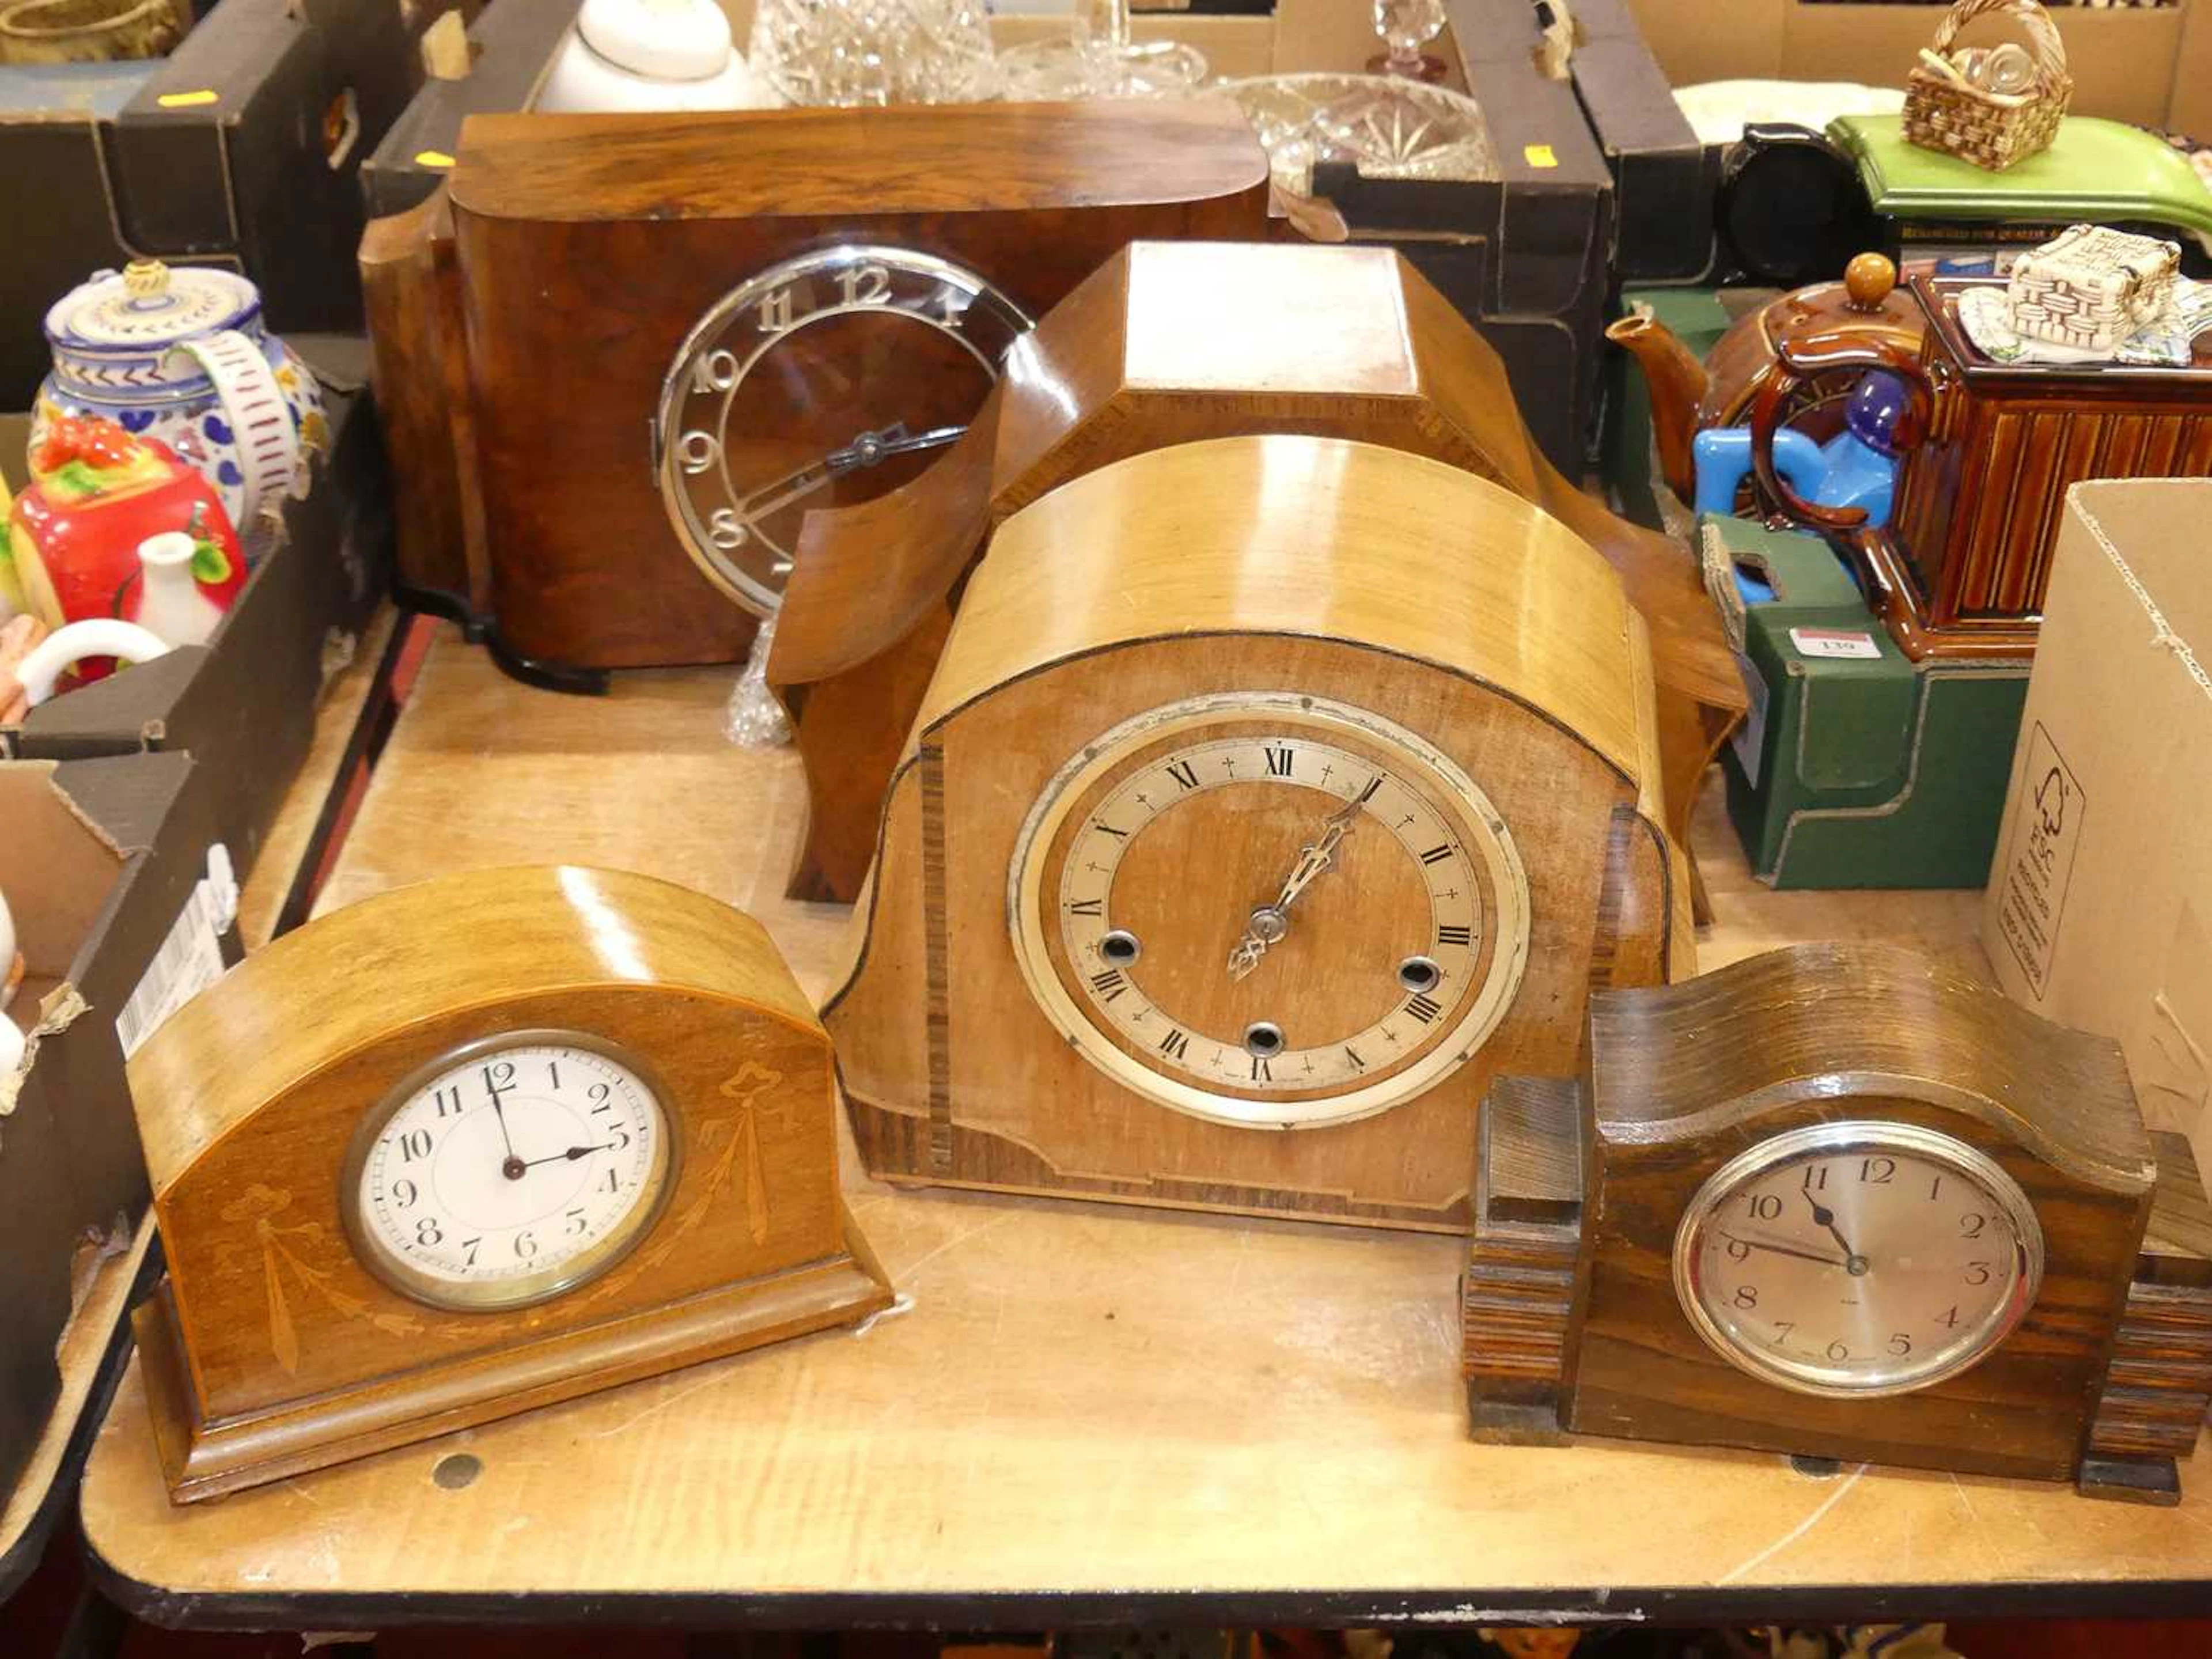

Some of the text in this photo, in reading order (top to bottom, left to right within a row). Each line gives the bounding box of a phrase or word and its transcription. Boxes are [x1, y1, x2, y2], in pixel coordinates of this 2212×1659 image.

[834, 267, 892, 305] 12
[755, 289, 793, 331] 11
[693, 349, 740, 393] 10
[681, 430, 720, 474] 9
[710, 508, 749, 548] 8
[1264, 748, 1294, 777] XII
[1166, 760, 1199, 792] XI
[1420, 843, 1453, 866] II
[1439, 925, 1471, 946] III
[483, 1062, 517, 1095] 12
[547, 1062, 560, 1090] 1
[434, 1085, 463, 1117] 11
[588, 1083, 612, 1114] 2
[400, 1129, 433, 1162] 10
[599, 1168, 622, 1194] 4
[1803, 1165, 1827, 1190] 11
[1859, 1158, 1896, 1183] 12
[393, 1179, 418, 1207] 9
[1930, 1176, 1941, 1200] 1
[1748, 1195, 1783, 1219] 10
[416, 1218, 442, 1247] 8
[566, 1208, 587, 1234] 5
[1960, 1214, 1985, 1239] 2
[463, 1237, 482, 1266] 7
[514, 1232, 537, 1259] 6
[1728, 1240, 1750, 1263] 9
[1964, 1262, 1990, 1285] 3
[1734, 1285, 1759, 1310] 8
[1934, 1305, 1959, 1328] 4
[1775, 1322, 1795, 1346] 7
[1889, 1334, 1911, 1356] 5
[1827, 1341, 1849, 1362] 6
